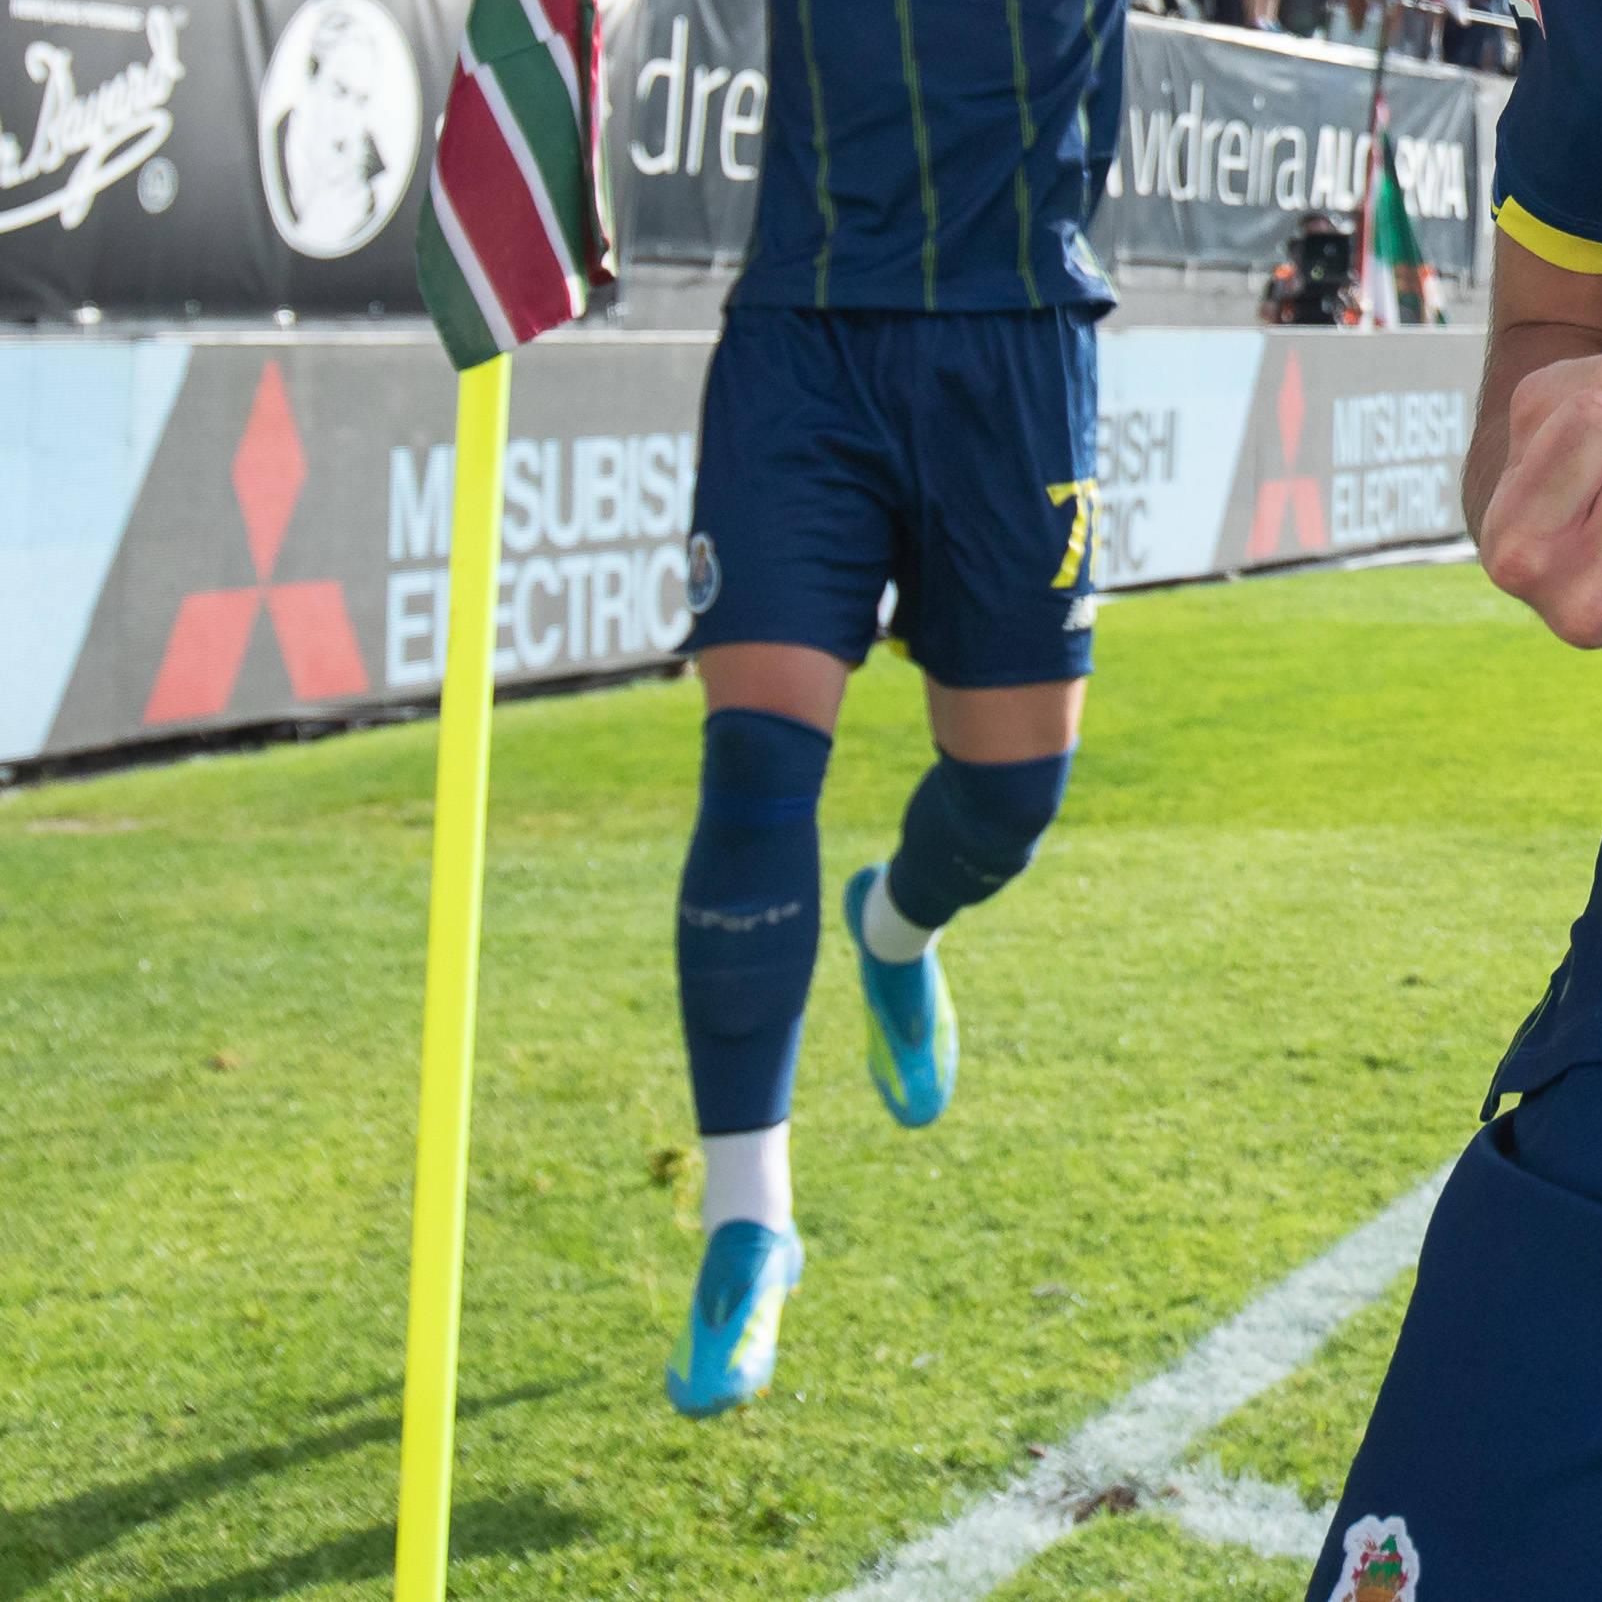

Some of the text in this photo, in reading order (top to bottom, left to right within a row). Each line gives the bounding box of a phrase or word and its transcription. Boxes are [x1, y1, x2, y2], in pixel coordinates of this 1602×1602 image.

[1128, 79, 1307, 211] vidreira
[1332, 388, 1465, 466] MITSUBISHI
[388, 431, 699, 563] MSUBIS
[1330, 464, 1452, 544] ELECTRIC
